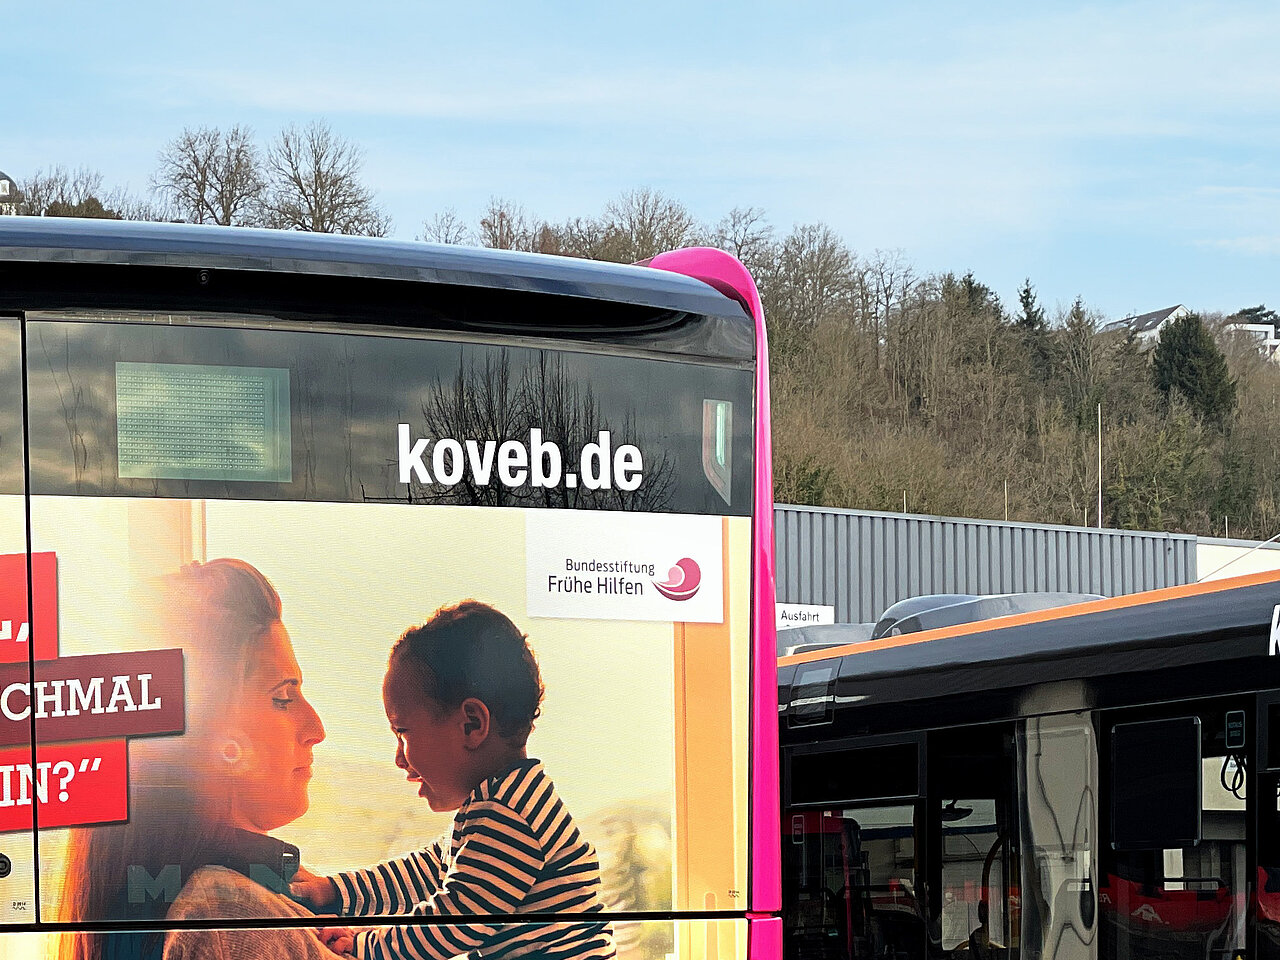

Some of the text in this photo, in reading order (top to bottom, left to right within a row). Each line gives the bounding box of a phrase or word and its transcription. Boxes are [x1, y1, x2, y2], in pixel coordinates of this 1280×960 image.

[397, 423, 644, 492] koveb.de
[565, 558, 655, 577] Bundesstiftung
[548, 574, 644, 596] Frühe Hilfen
[780, 609, 820, 623] Ausfahrt
